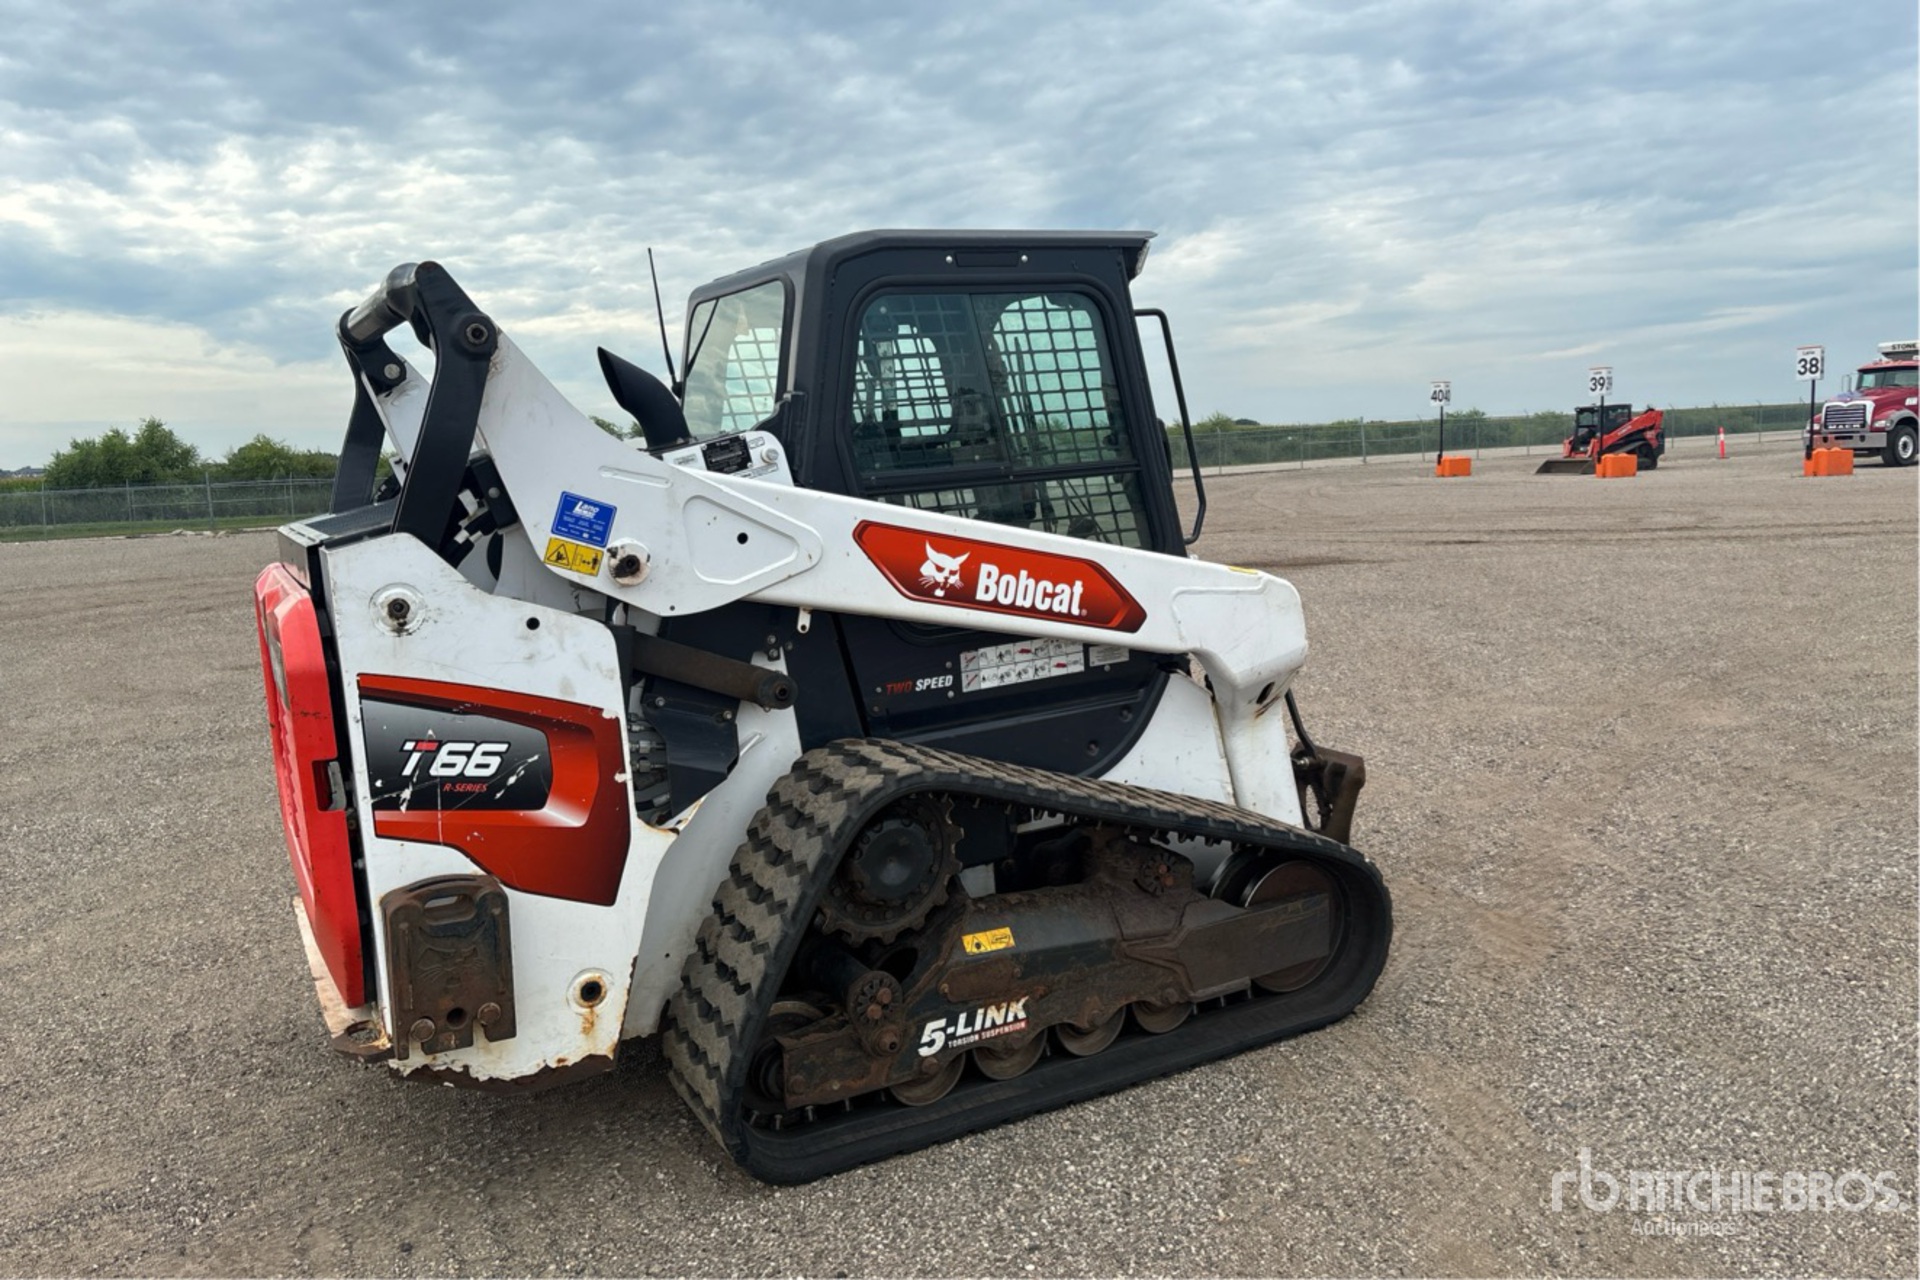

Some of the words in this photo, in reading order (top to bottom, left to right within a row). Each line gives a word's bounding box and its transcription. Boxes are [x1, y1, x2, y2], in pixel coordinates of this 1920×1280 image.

[1797, 356, 1819, 376] 38
[1590, 376, 1606, 392] 39
[1430, 389, 1444, 403] 40
[975, 562, 1084, 617] Bobcat
[886, 680, 913, 694] TWO
[915, 674, 953, 692] SPEED
[401, 740, 510, 778] T66
[443, 782, 489, 793] R-SERIES
[917, 996, 1030, 1057] 5-LINK
[948, 1034, 980, 1048] TORSION
[981, 1021, 1027, 1040] SUSPENSION
